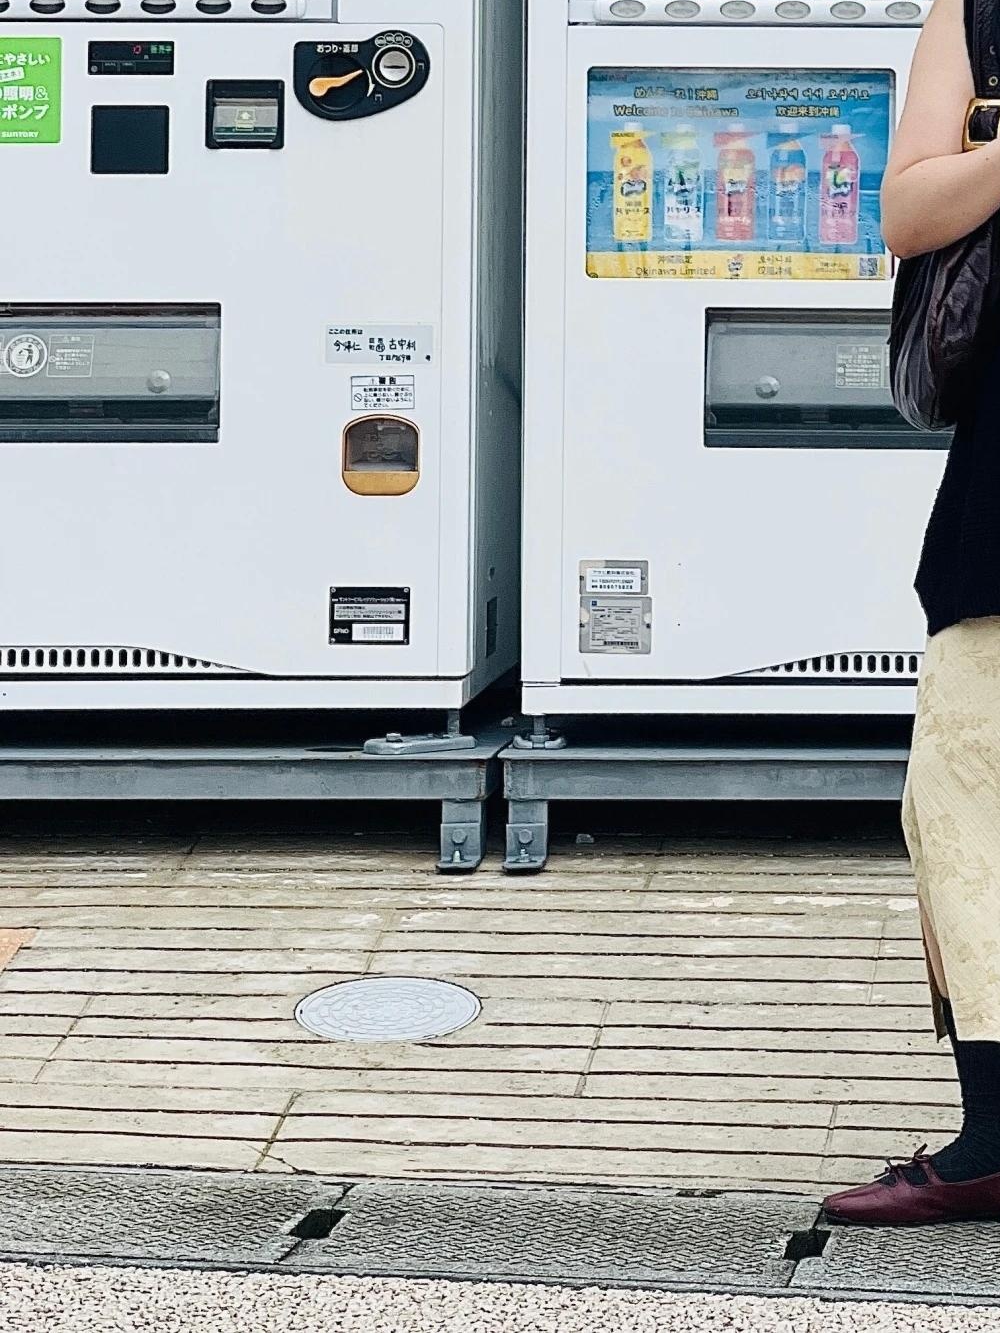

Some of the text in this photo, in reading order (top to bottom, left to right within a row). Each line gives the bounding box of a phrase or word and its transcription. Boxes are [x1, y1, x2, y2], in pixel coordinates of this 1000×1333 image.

[0, 85, 49, 101] 照明&
[1, 131, 39, 139] SUNTORY
[679, 265, 716, 276] Limited
